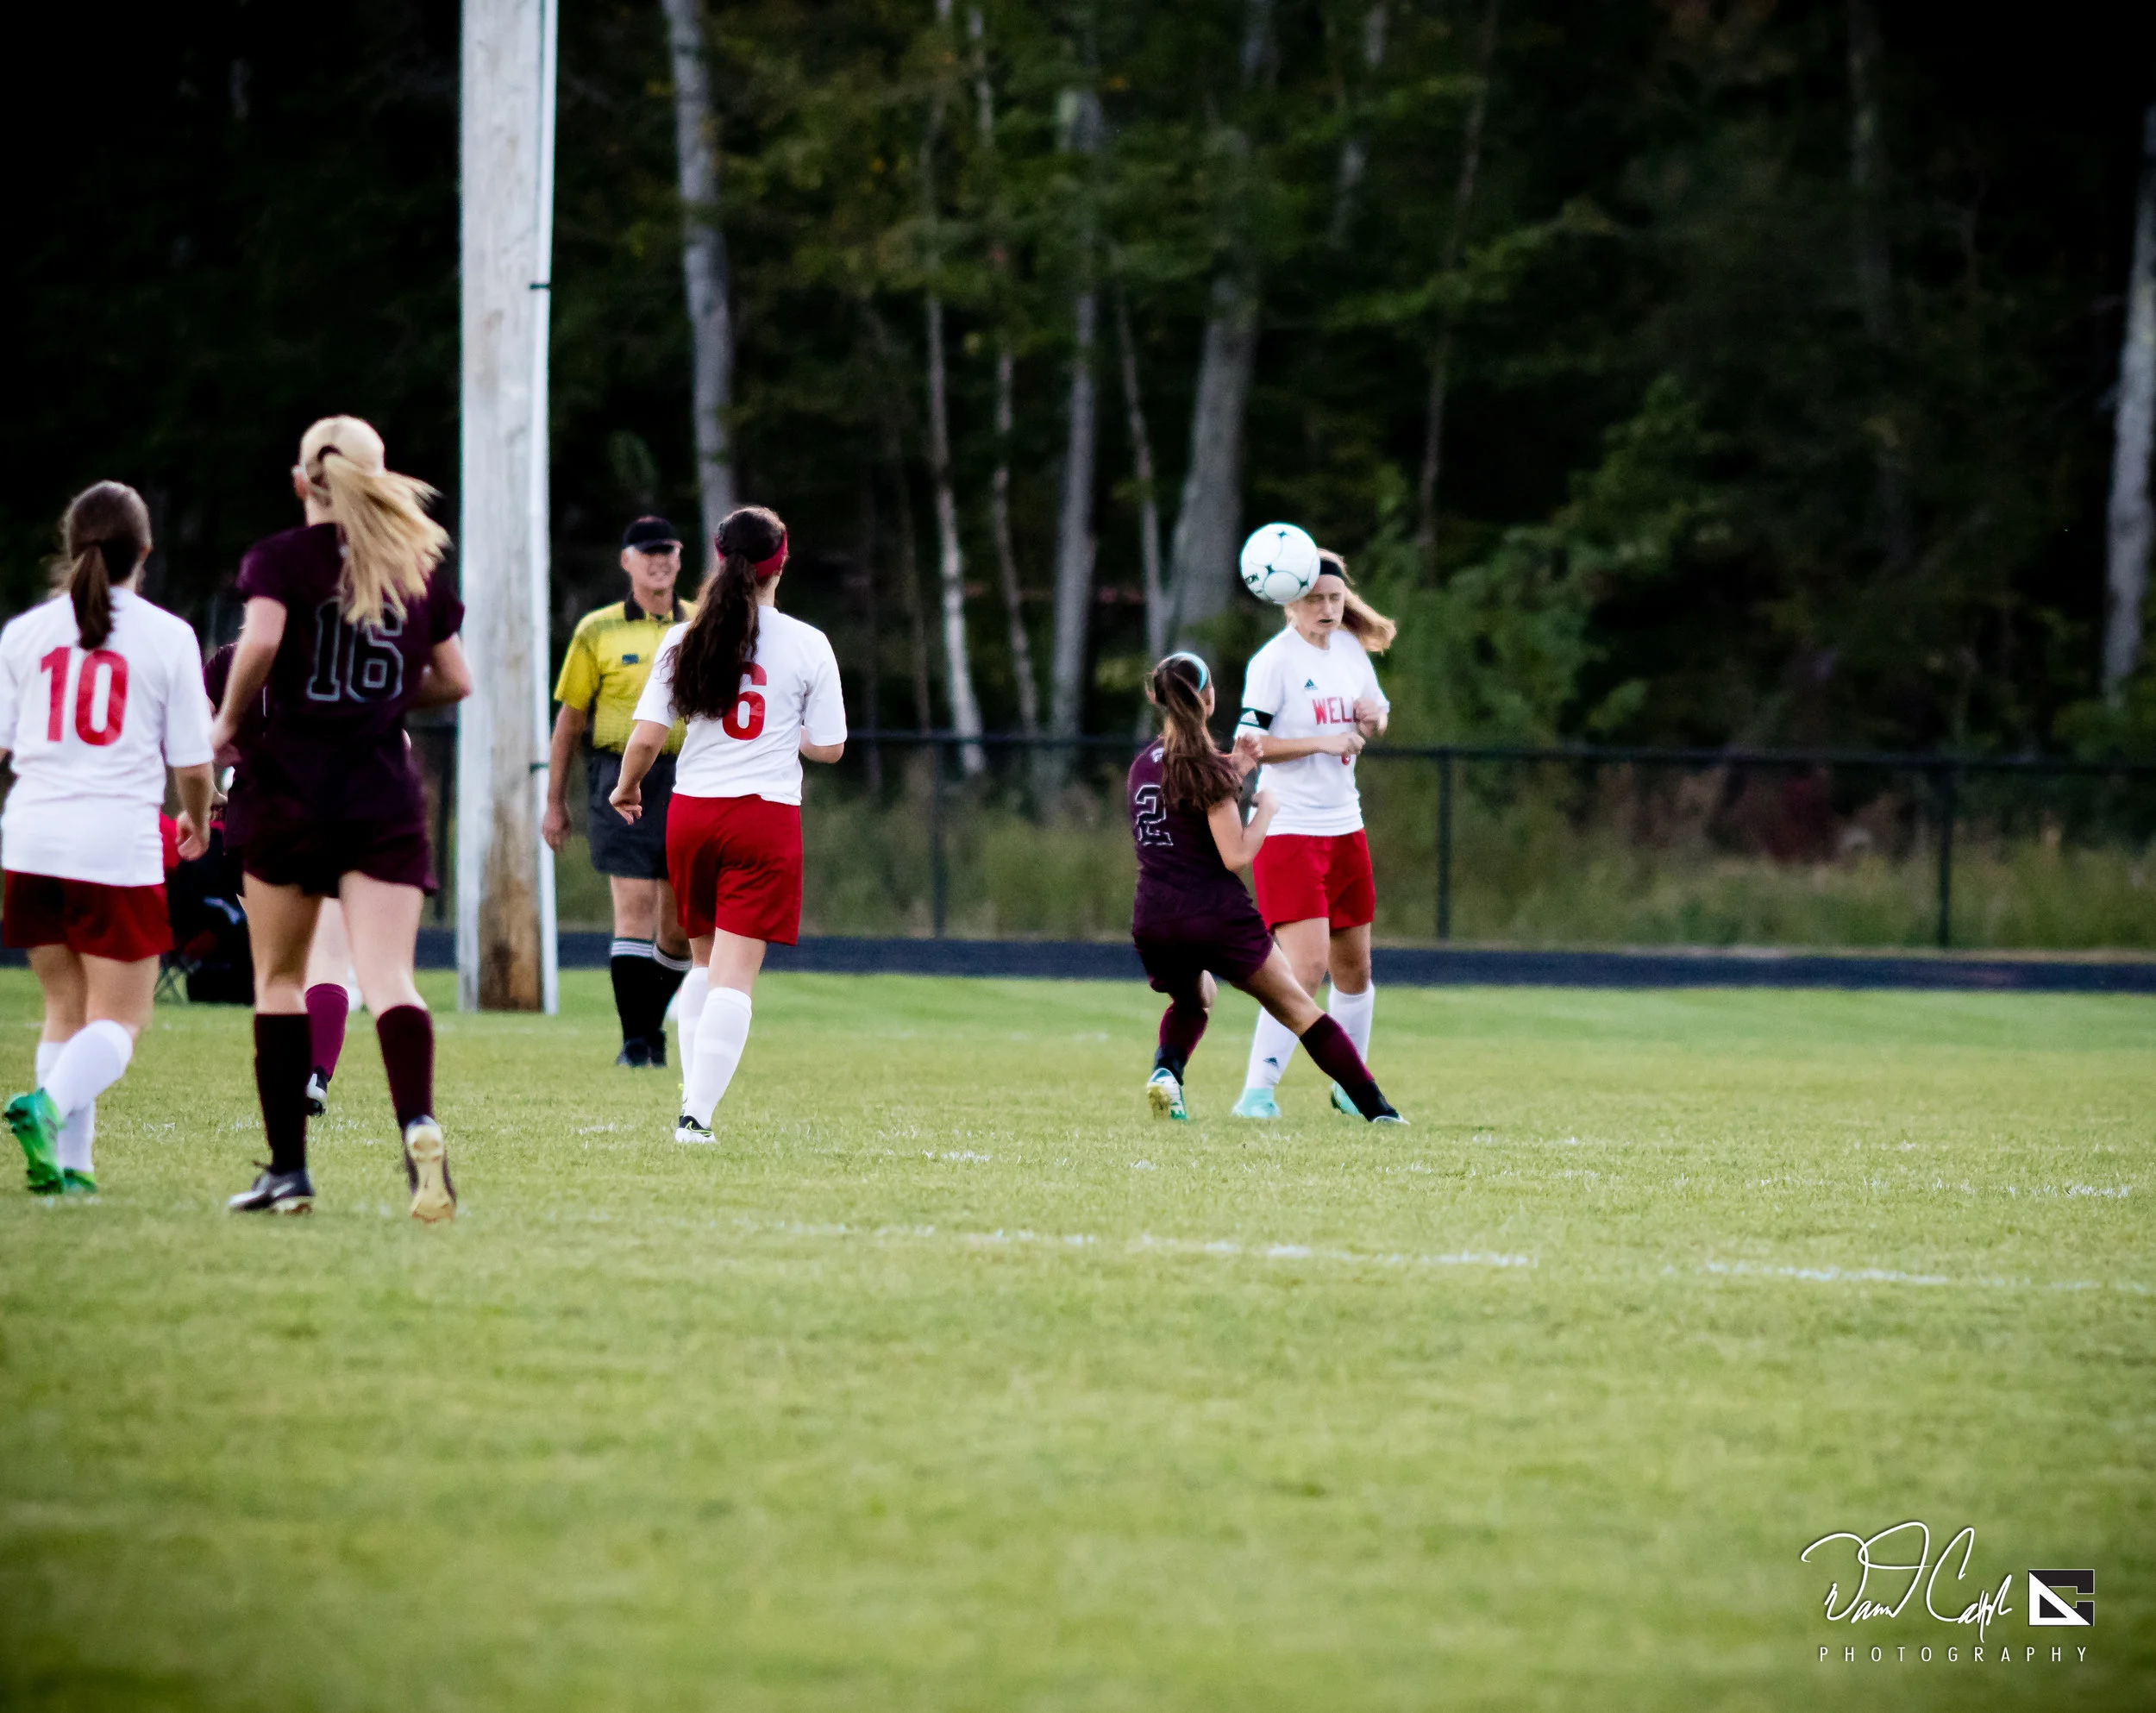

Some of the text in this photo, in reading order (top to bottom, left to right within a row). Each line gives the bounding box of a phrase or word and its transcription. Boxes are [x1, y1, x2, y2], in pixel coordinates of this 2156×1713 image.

[306, 597, 404, 703] 16
[40, 645, 128, 746] 10
[722, 662, 768, 741] 6
[1135, 784, 1174, 846] 2
